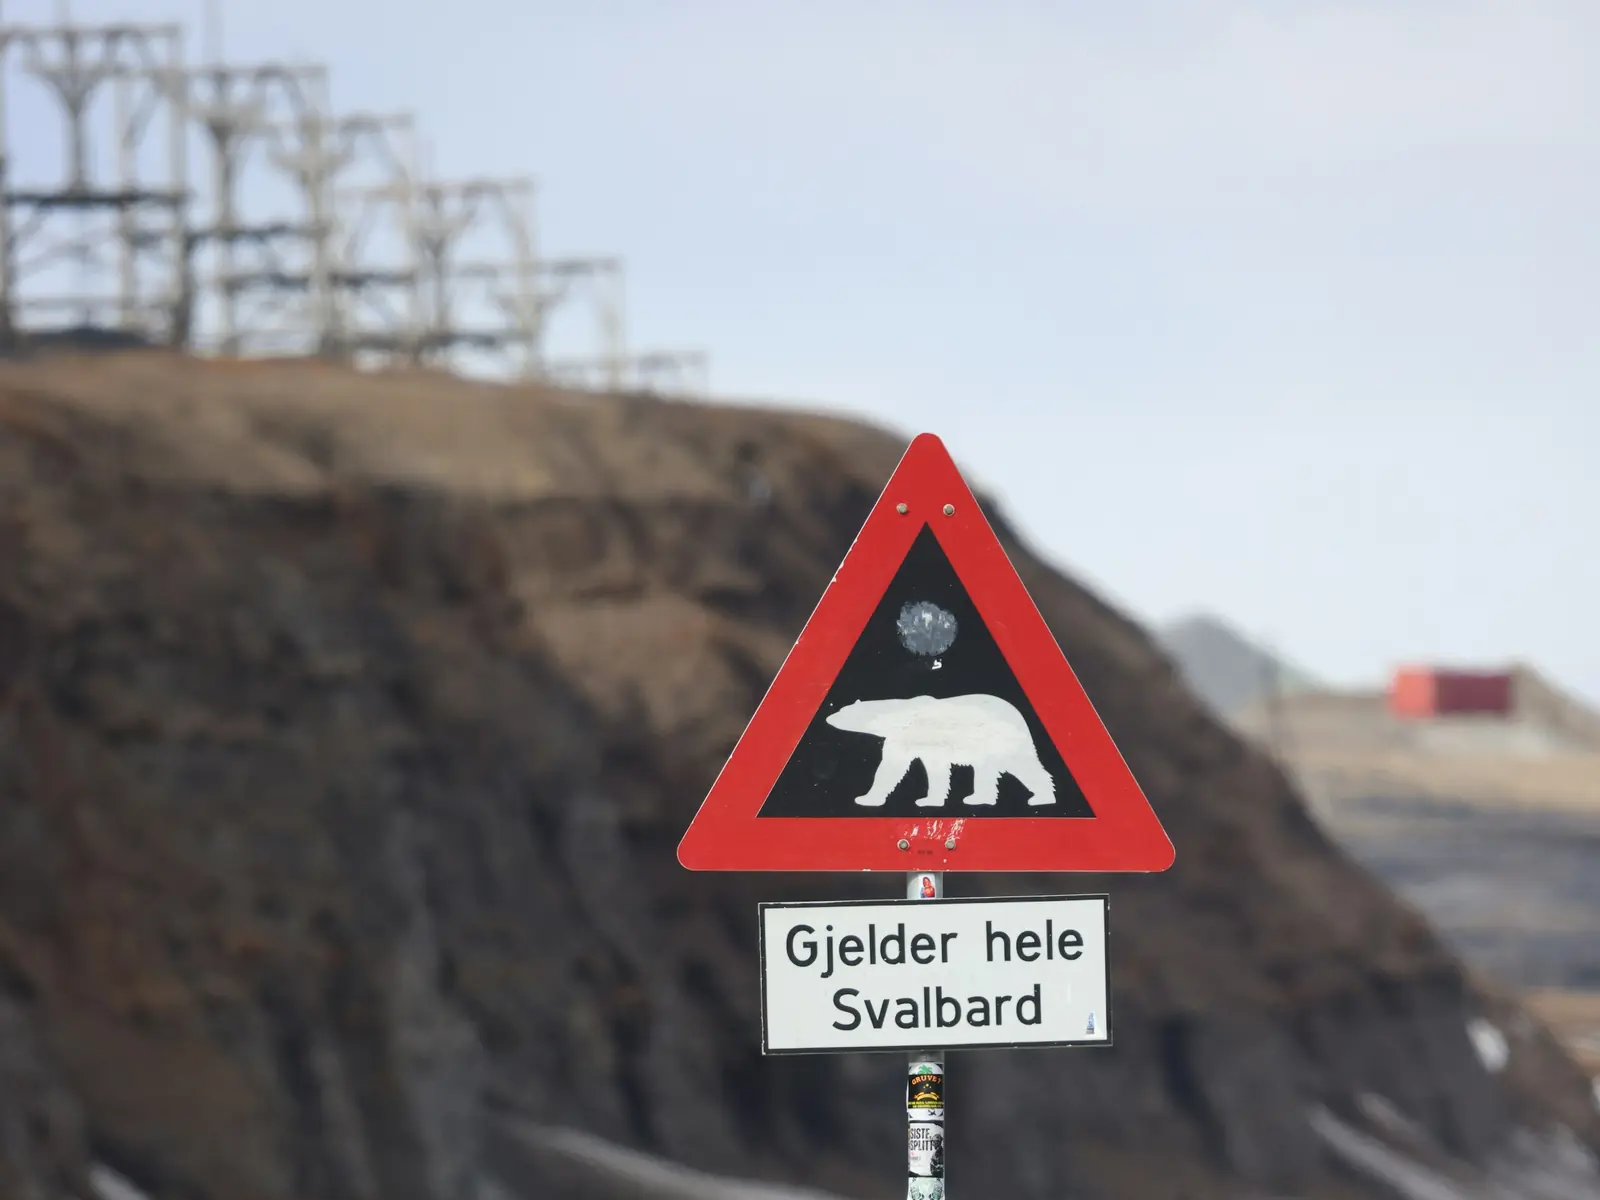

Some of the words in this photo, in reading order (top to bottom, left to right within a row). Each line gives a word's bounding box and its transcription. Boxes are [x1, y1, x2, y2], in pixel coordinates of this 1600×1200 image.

[787, 923, 957, 978] Gjelder
[986, 920, 1083, 961] hele
[833, 984, 1041, 1030] Svalbard
[911, 1075, 937, 1085] GRUVE
